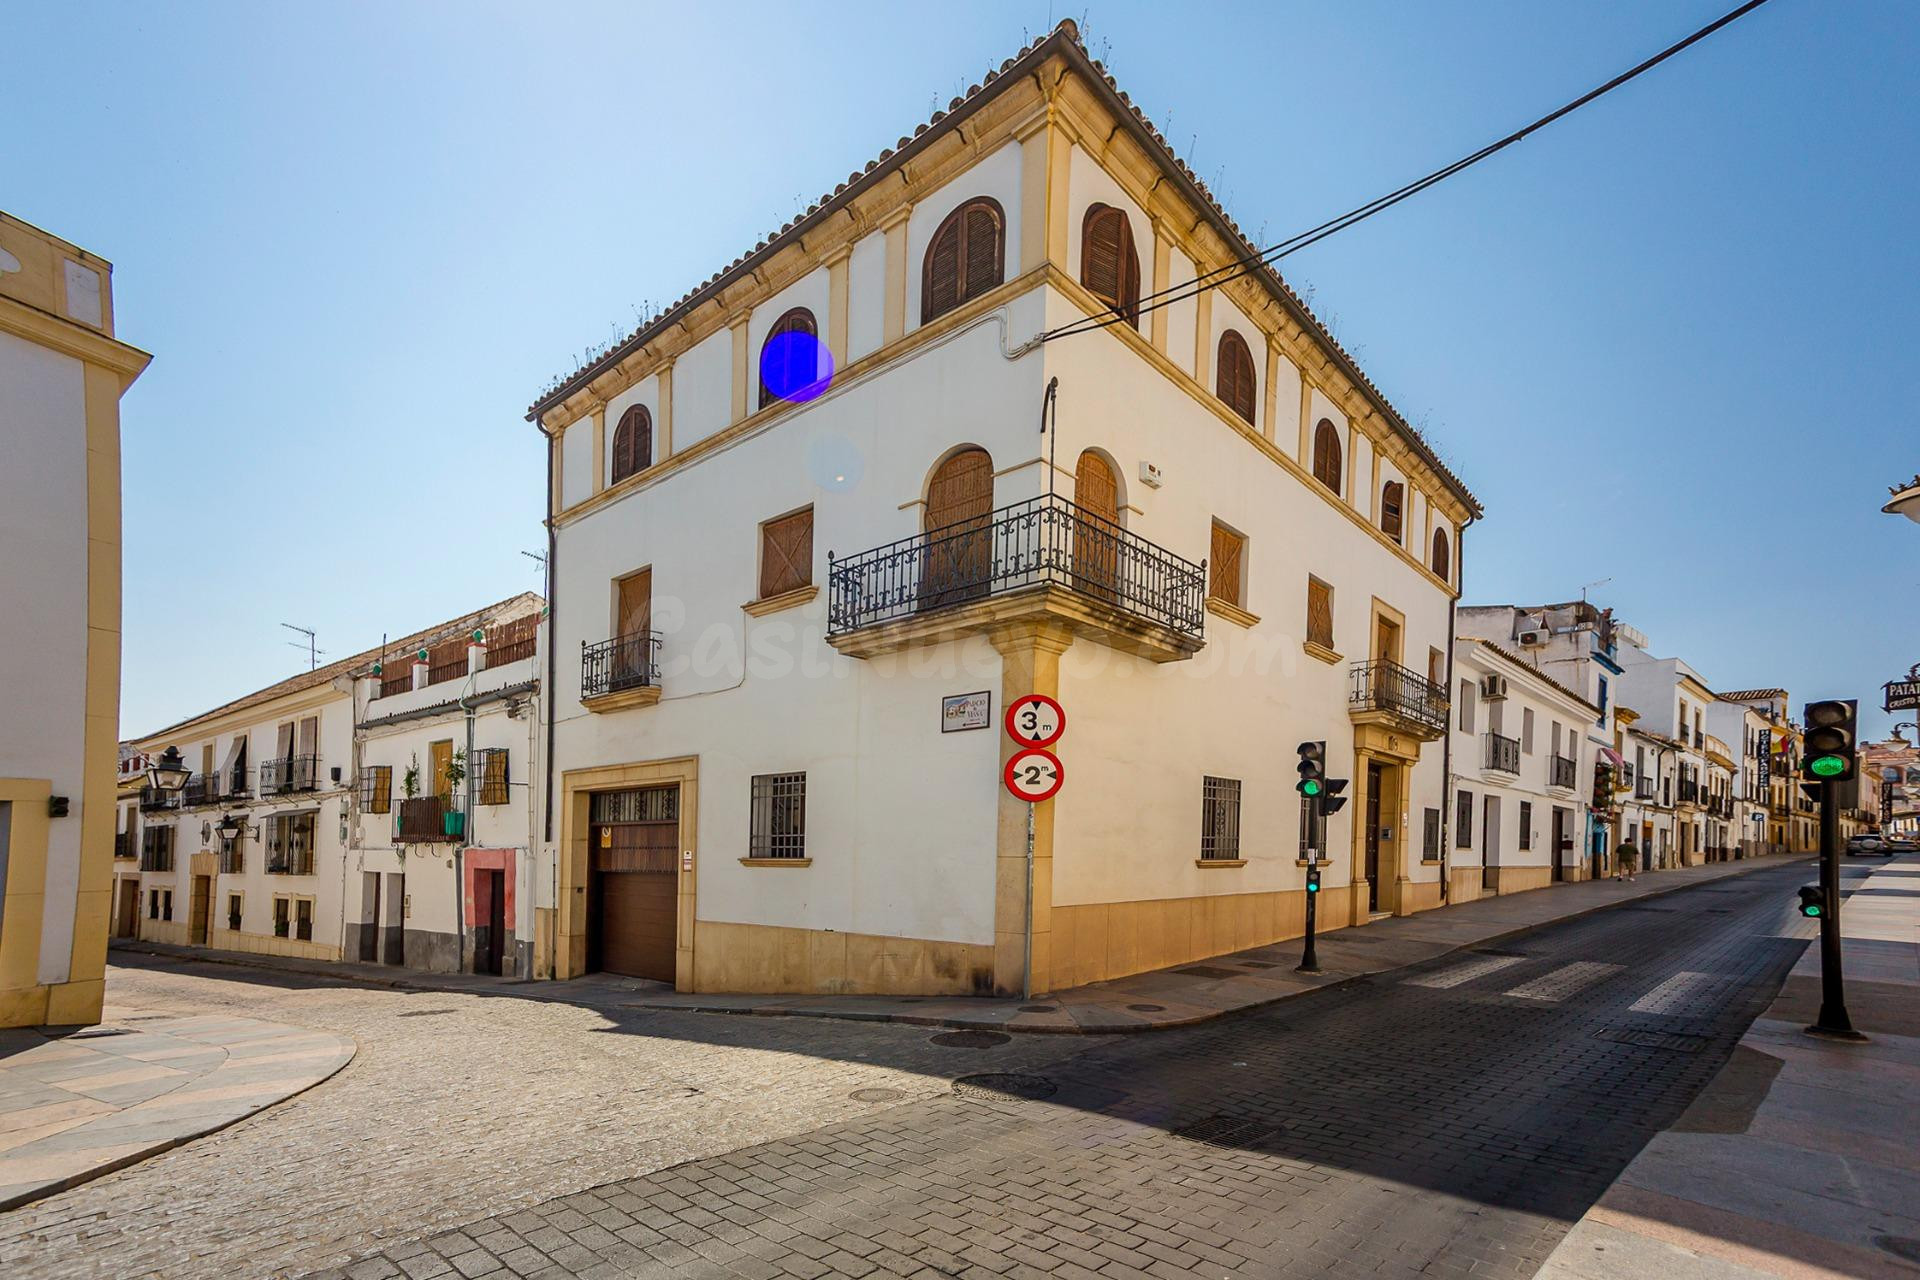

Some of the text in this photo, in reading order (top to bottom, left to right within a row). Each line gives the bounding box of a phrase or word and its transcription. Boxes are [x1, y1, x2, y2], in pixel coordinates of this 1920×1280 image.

[1021, 712, 1052, 731] 3 m
[1024, 766, 1041, 784] 2
